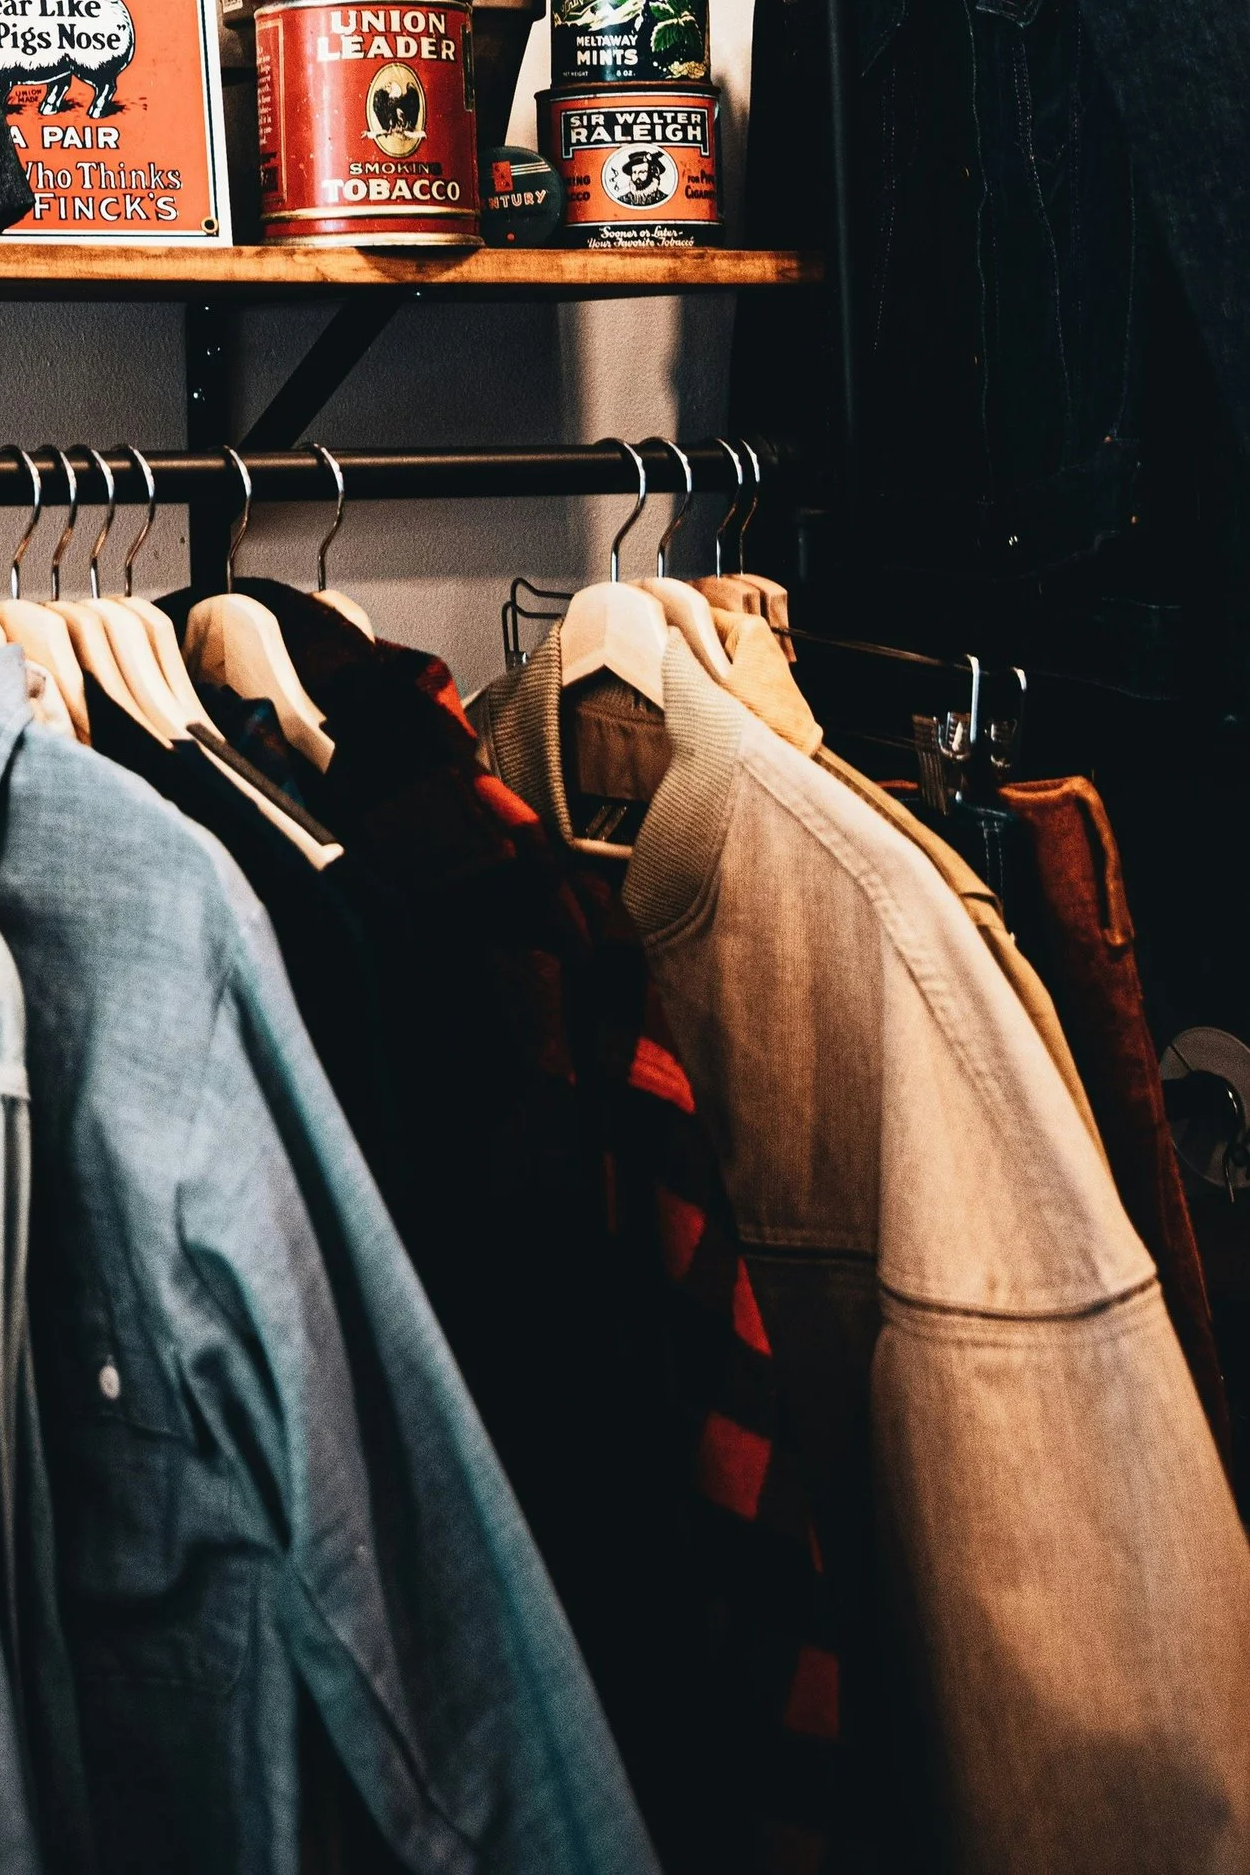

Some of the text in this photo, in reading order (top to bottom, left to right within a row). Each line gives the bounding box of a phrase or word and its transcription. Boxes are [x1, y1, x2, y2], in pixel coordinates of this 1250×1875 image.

[331, 10, 447, 36] UNION
[316, 36, 456, 62] LEADER
[576, 34, 638, 47] MELTAWAY
[577, 49, 639, 66] MINTS
[15, 89, 42, 98] UNION
[18, 95, 39, 103] MADE
[570, 111, 702, 127] SIR WALTER
[42, 125, 120, 149] PAIR
[570, 124, 702, 144] RALEIGH
[75, 161, 184, 191] Thinks
[349, 161, 442, 176] SMOKIN
[322, 178, 460, 202] TOBACCO
[484, 189, 547, 210] NTURY
[33, 192, 179, 221] FINCK'S
